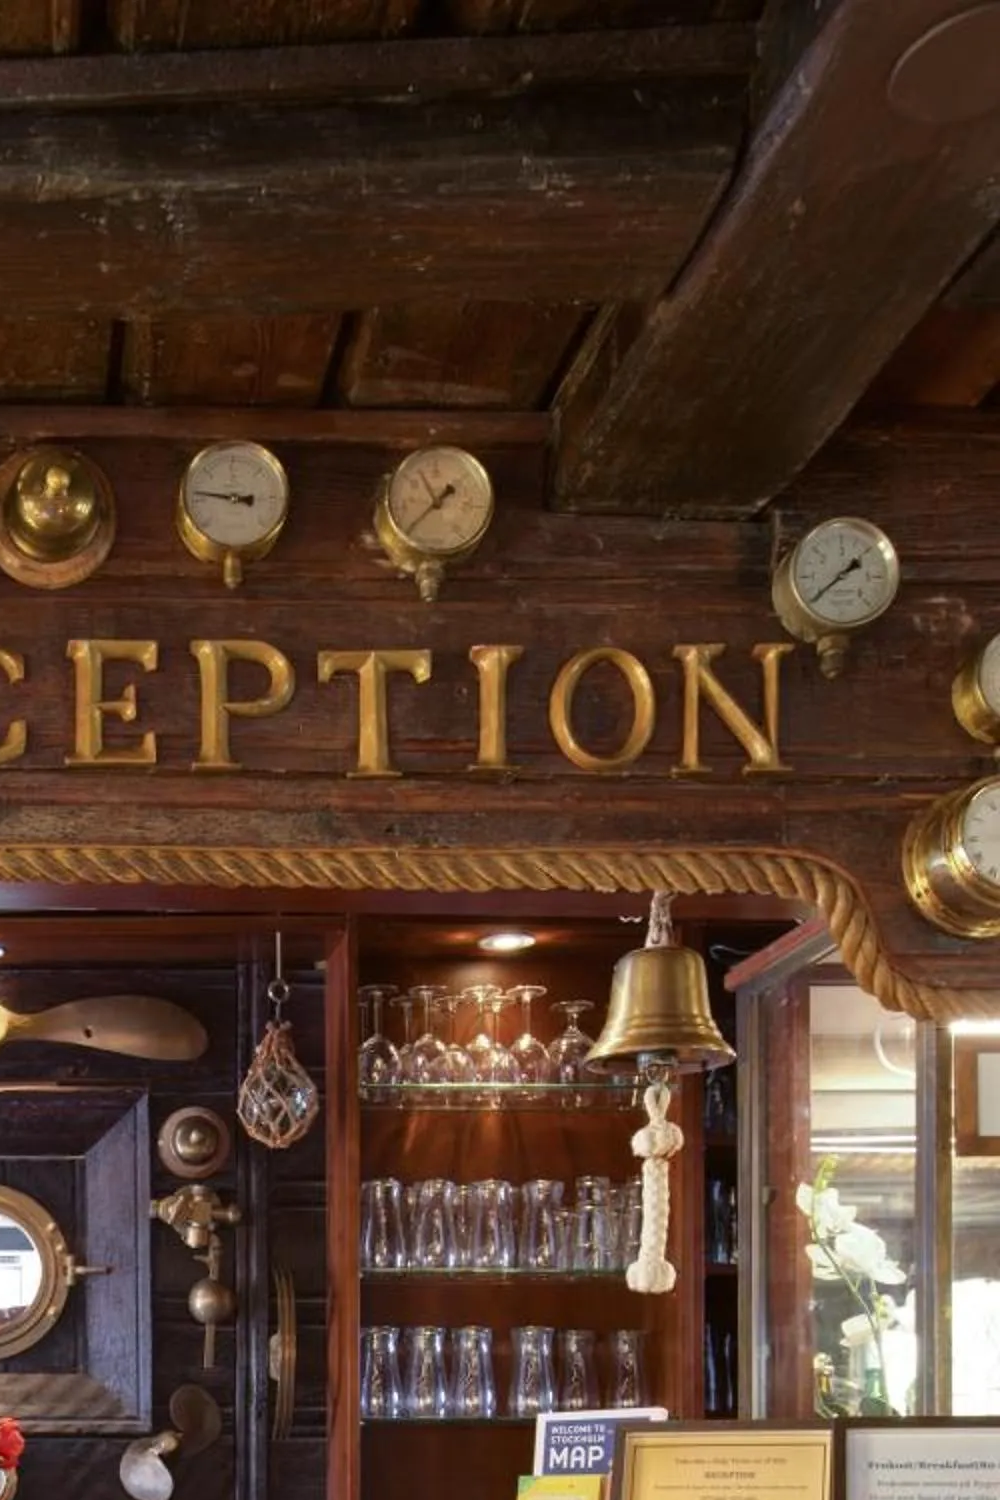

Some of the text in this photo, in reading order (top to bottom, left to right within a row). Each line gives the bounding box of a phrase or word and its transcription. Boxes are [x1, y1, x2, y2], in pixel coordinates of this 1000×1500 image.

[551, 1424, 606, 1435] WELCOME TO
[551, 1435, 606, 1444] STOCKHOLM
[549, 1445, 605, 1470] MAP
